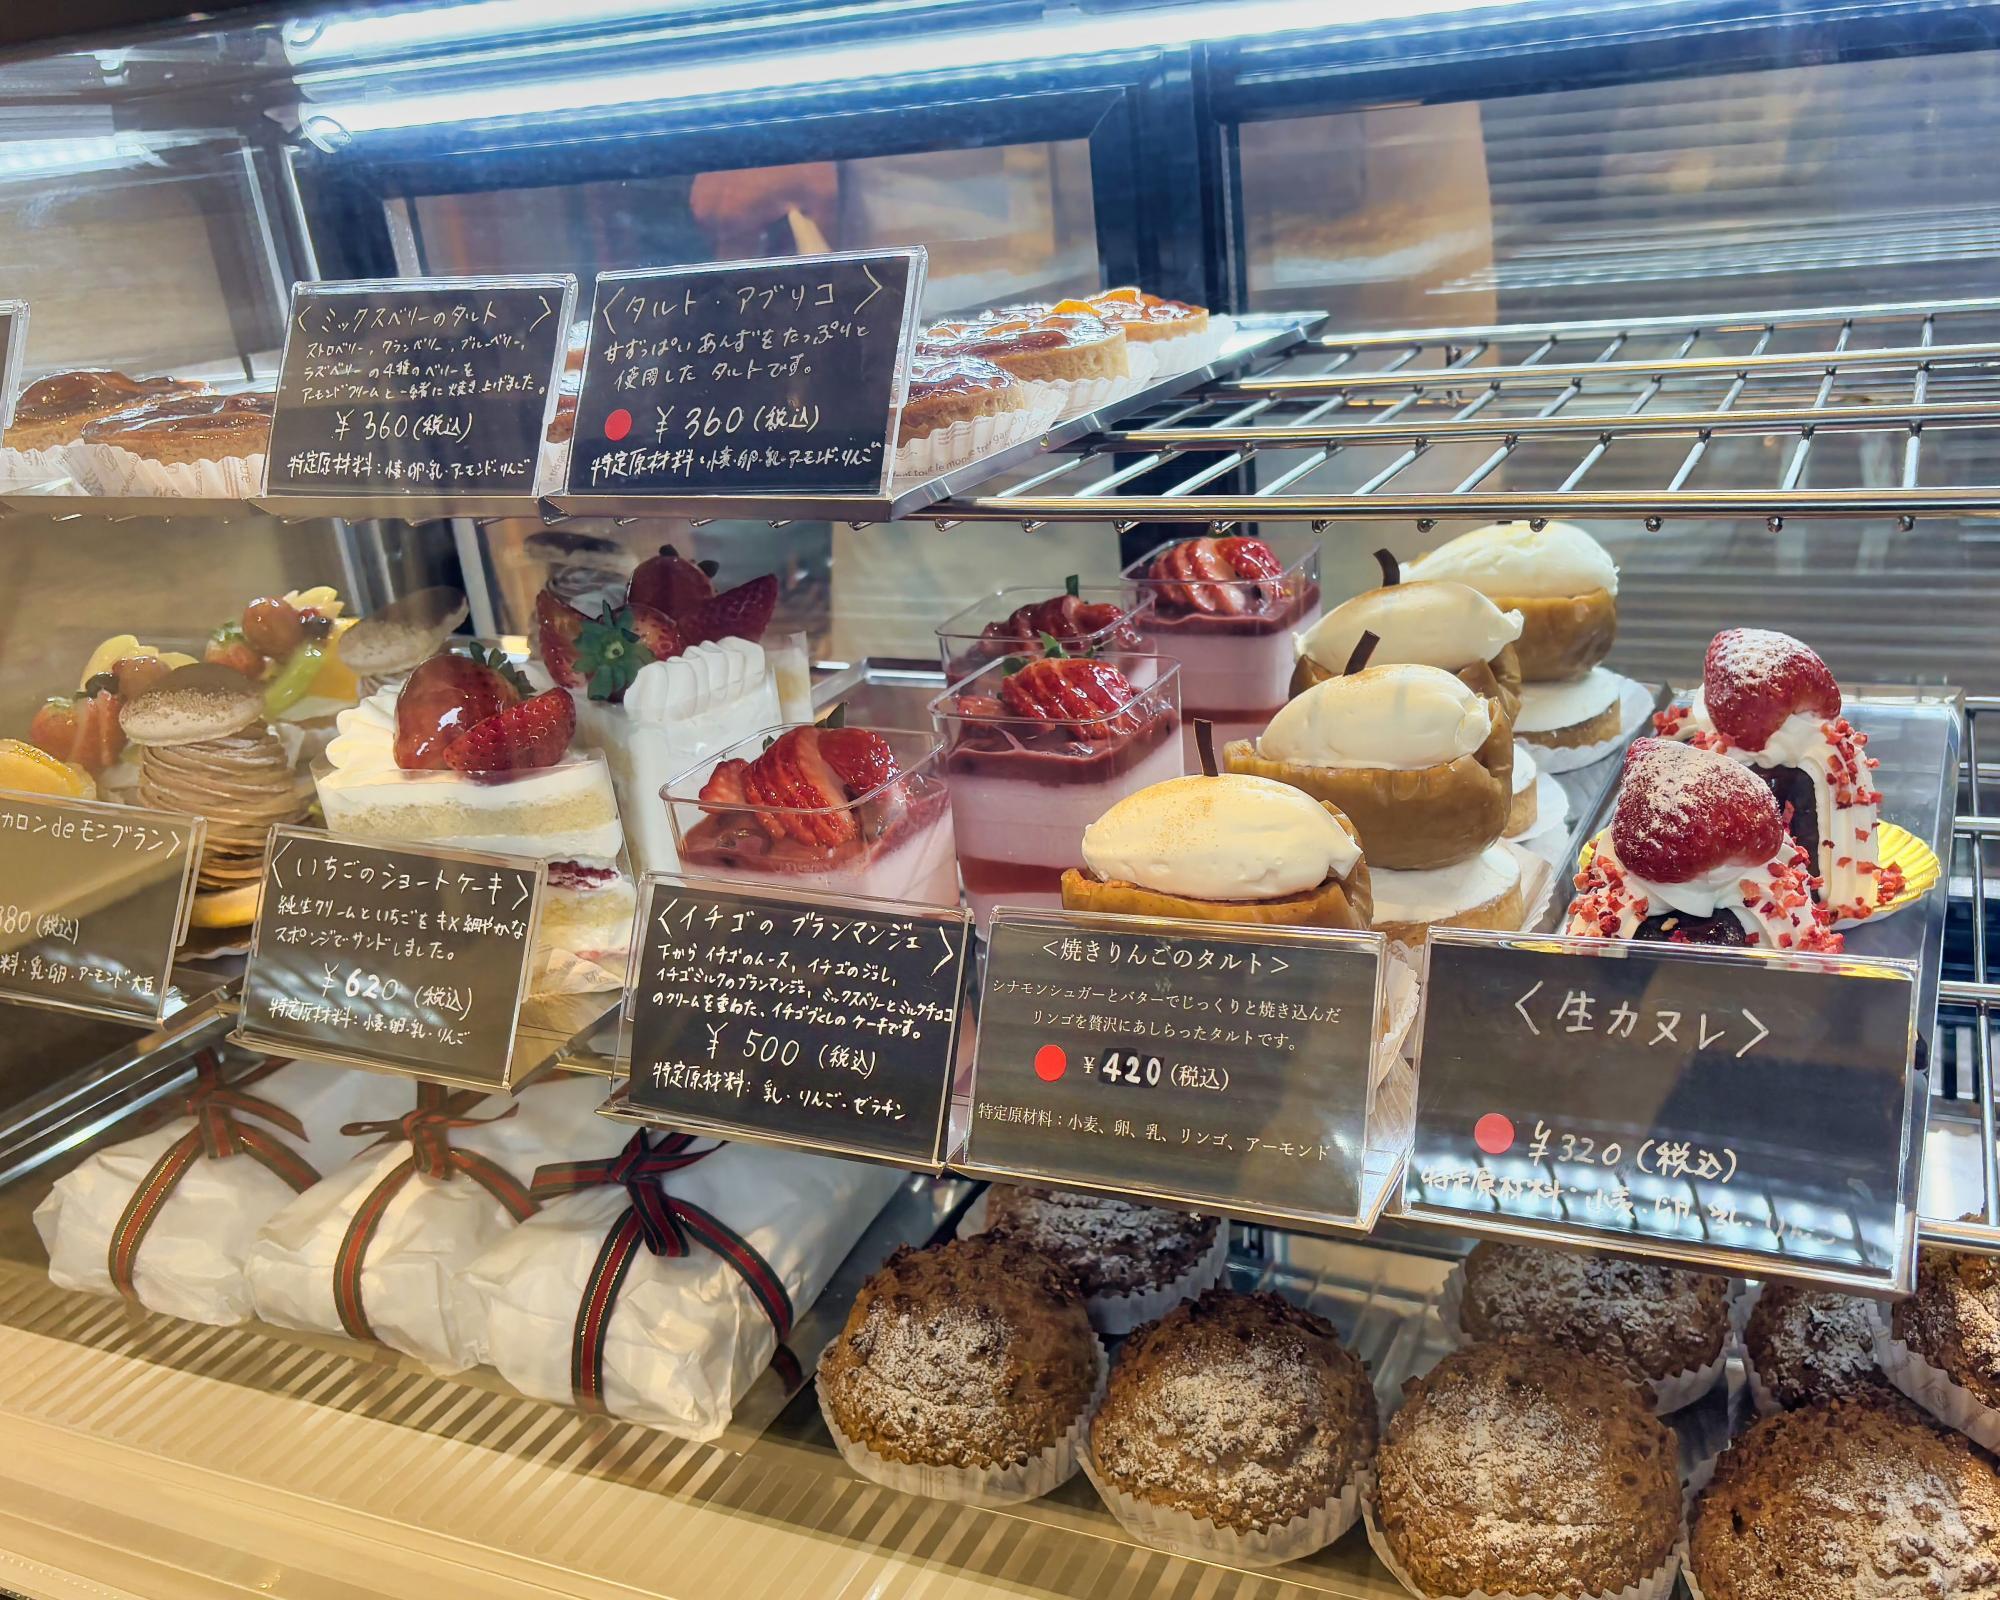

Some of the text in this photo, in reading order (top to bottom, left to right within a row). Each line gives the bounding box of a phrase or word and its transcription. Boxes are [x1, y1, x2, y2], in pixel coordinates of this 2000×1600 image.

[0, 811, 181, 859] カロンdeモンブラン〉
[991, 977, 1343, 1025] シナモンシュガーとバターでじっくりと焼き込んだ
[1031, 1009, 1298, 1052] リンゴを贅沢にあしらったタルトです。
